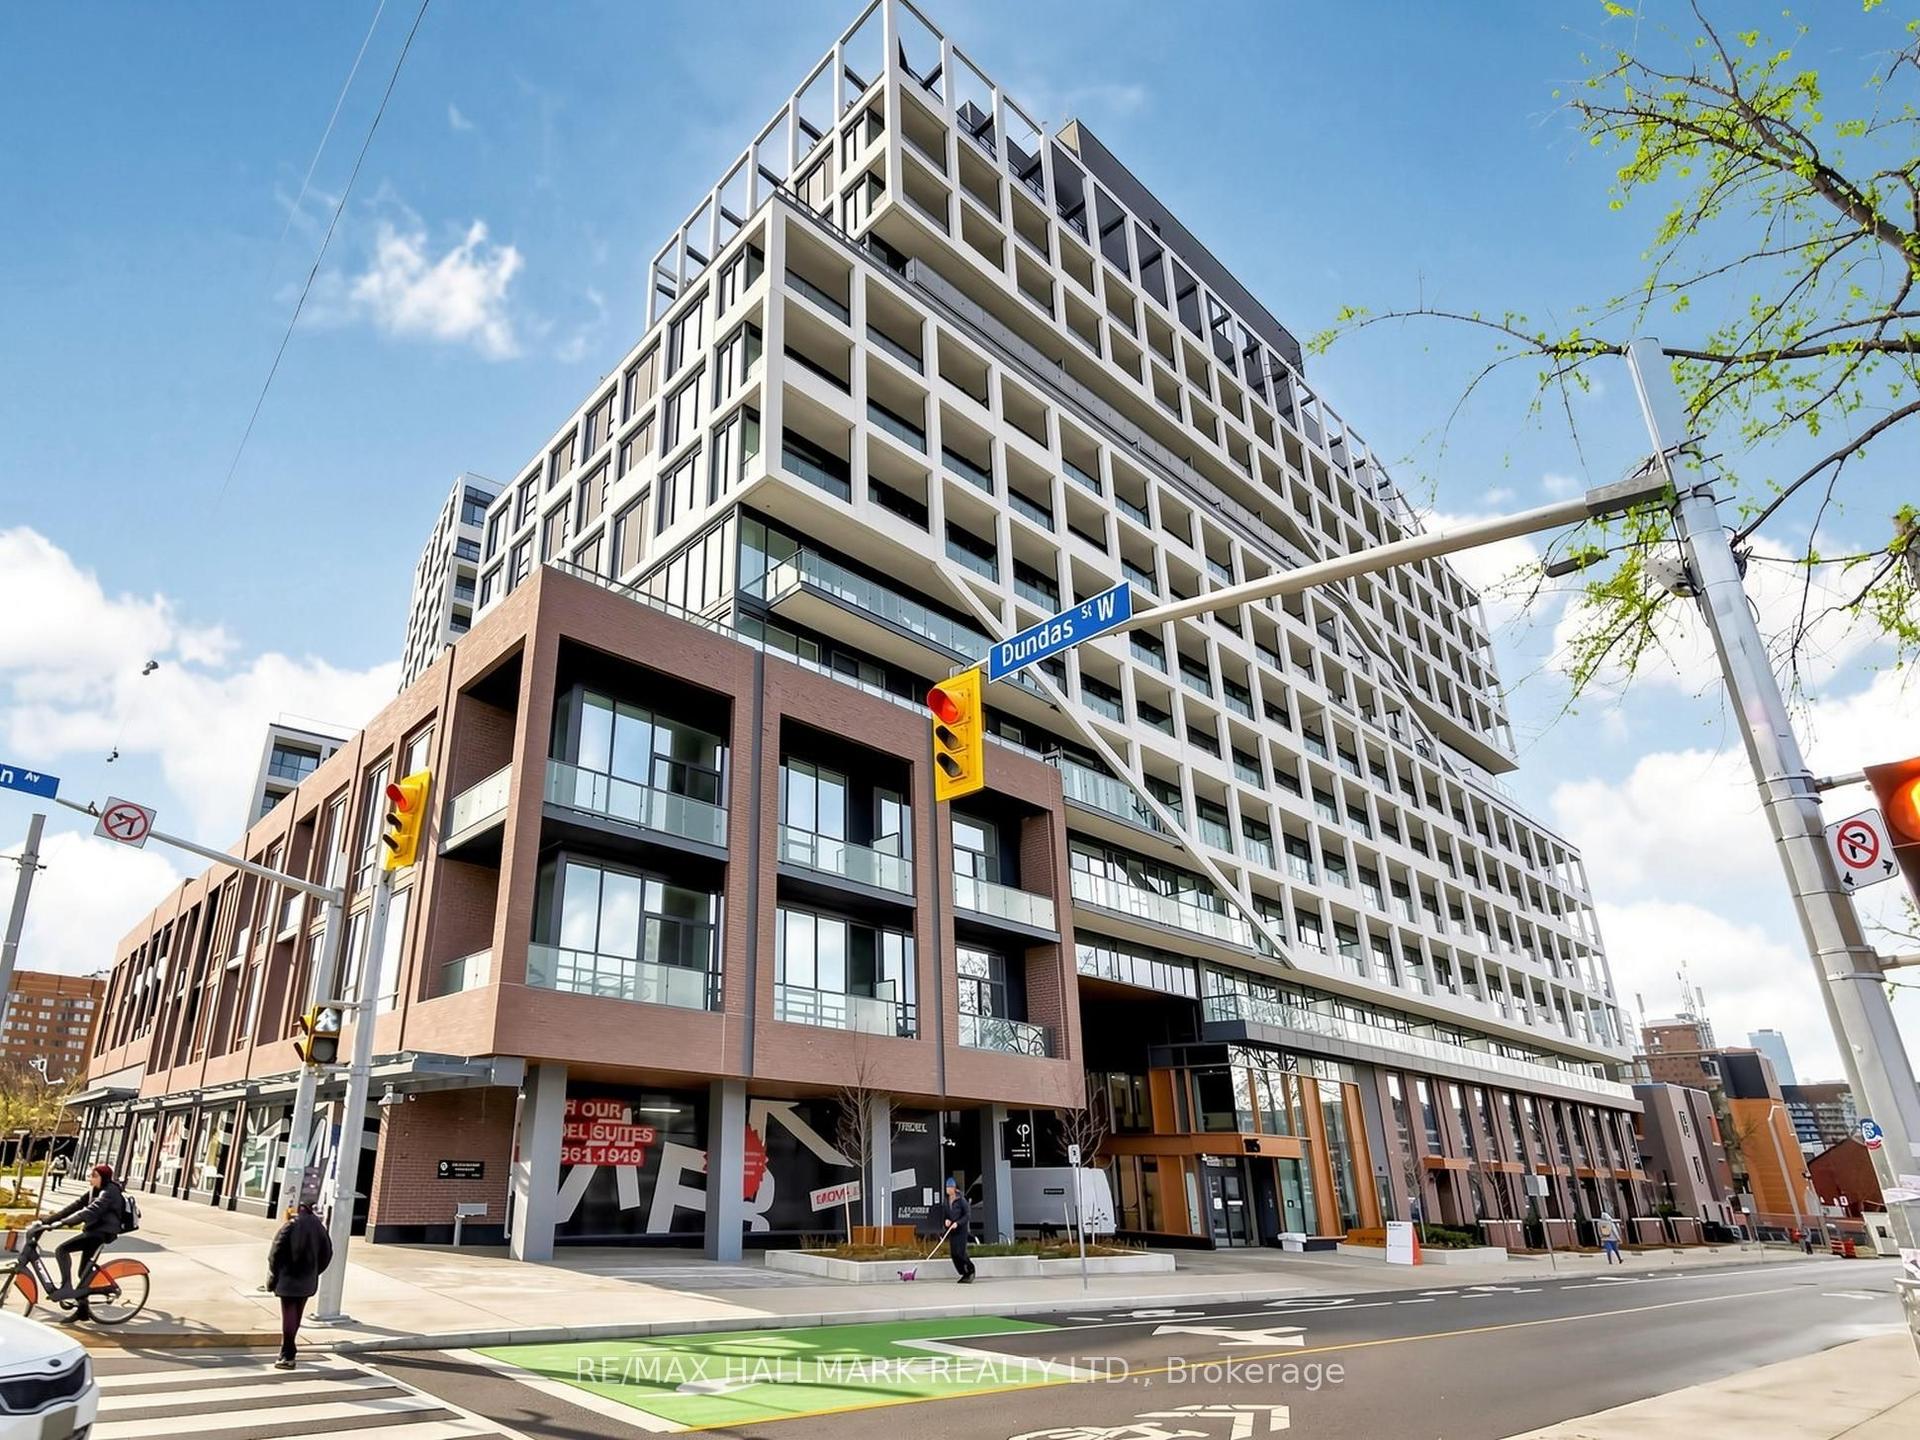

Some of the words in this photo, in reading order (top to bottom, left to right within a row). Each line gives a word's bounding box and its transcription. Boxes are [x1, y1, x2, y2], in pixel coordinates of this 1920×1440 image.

[1002, 619, 1074, 667] Dundas
[1081, 604, 1092, 619] St
[1097, 592, 1115, 621] W
[582, 1102, 621, 1117] OUR
[592, 1125, 653, 1143] SUITES
